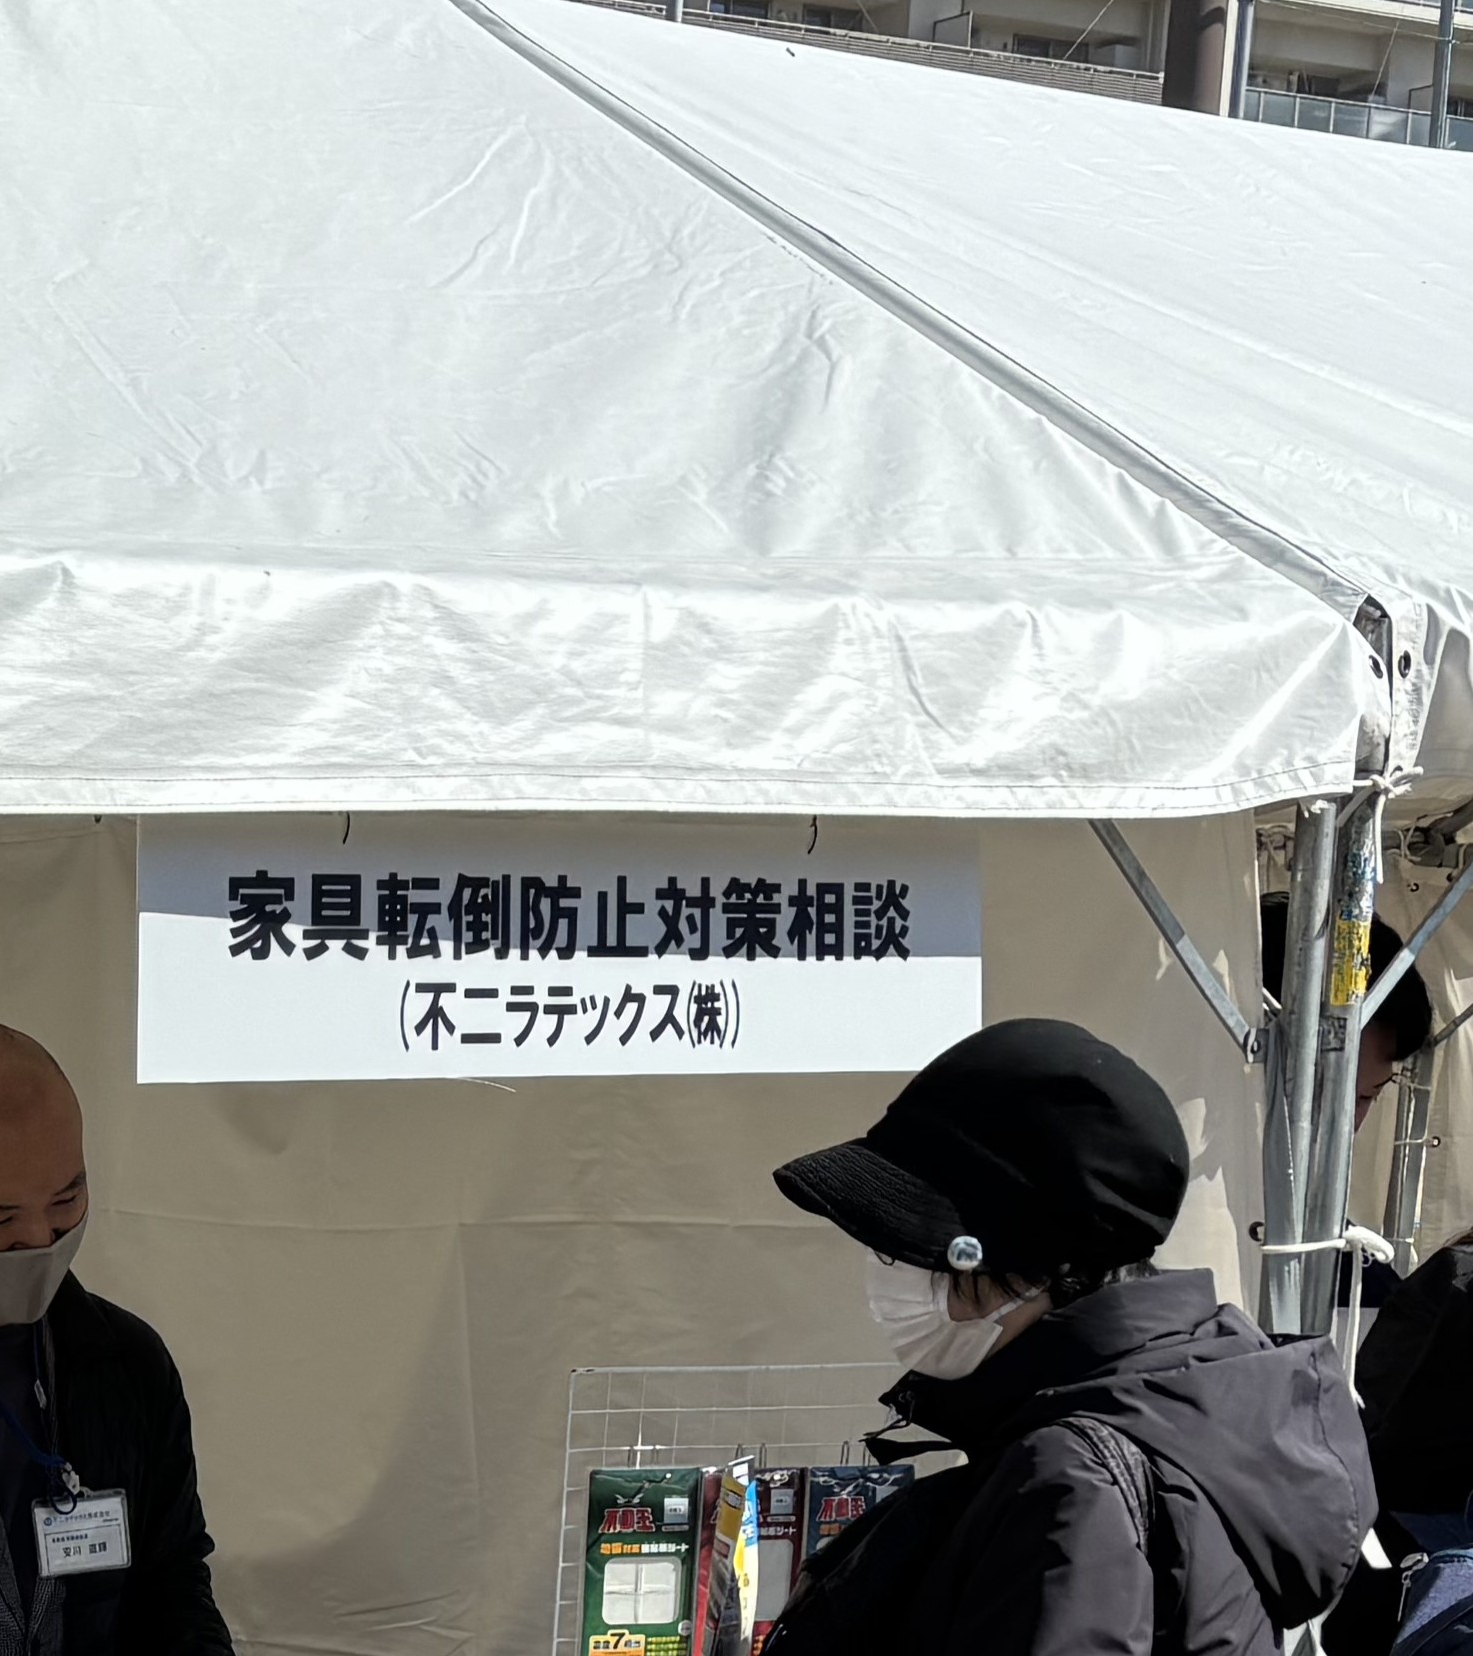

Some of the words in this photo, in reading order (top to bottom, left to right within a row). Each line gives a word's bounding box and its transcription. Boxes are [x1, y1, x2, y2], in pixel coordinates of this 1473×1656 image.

[228, 870, 912, 962] 家具転倒防止対策相談
